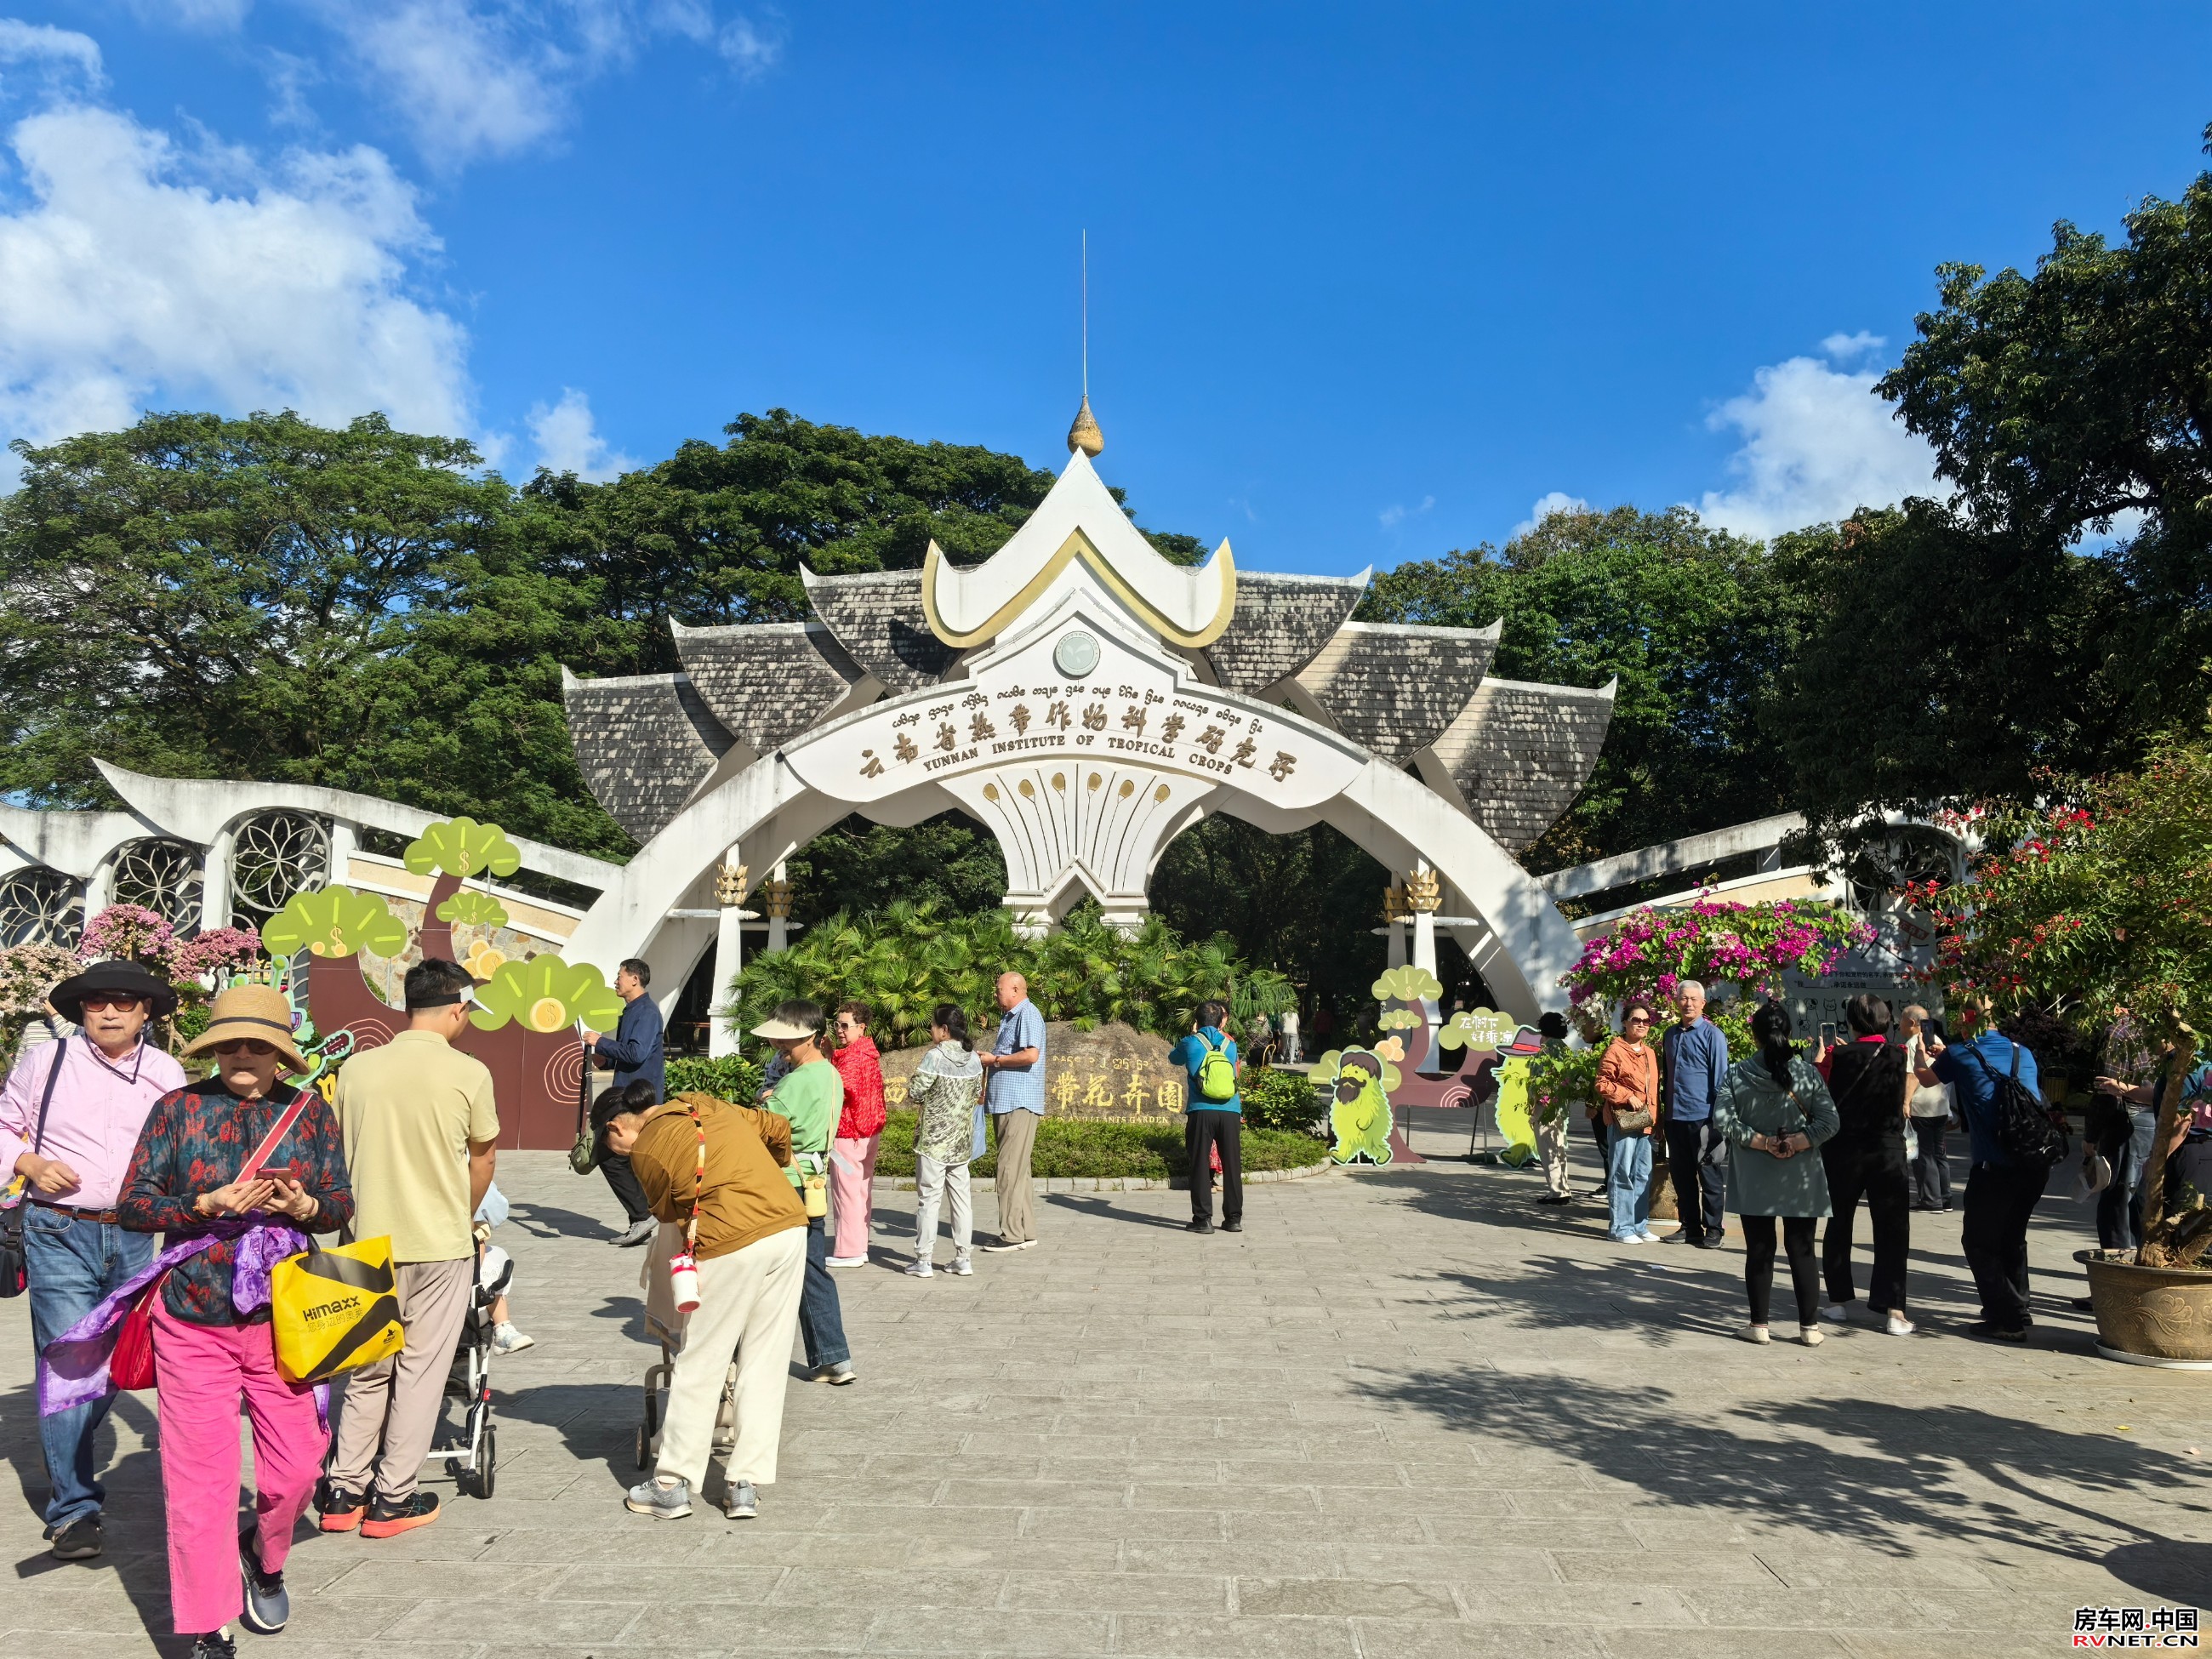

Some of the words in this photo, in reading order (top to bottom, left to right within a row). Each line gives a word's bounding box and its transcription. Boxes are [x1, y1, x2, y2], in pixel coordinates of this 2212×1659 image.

[923, 747, 979, 772] YUNNAN
[992, 735, 1065, 755] INSTITUTE
[1076, 734, 1094, 745] OF
[1108, 737, 1176, 759] TROPICAL
[1189, 753, 1233, 775] CROPS
[1459, 1014, 1499, 1029] 在树下
[1470, 1029, 1513, 1044] 好乘凉
[1129, 1115, 1170, 1124] GARDEN
[302, 1296, 361, 1321] Himaxx
